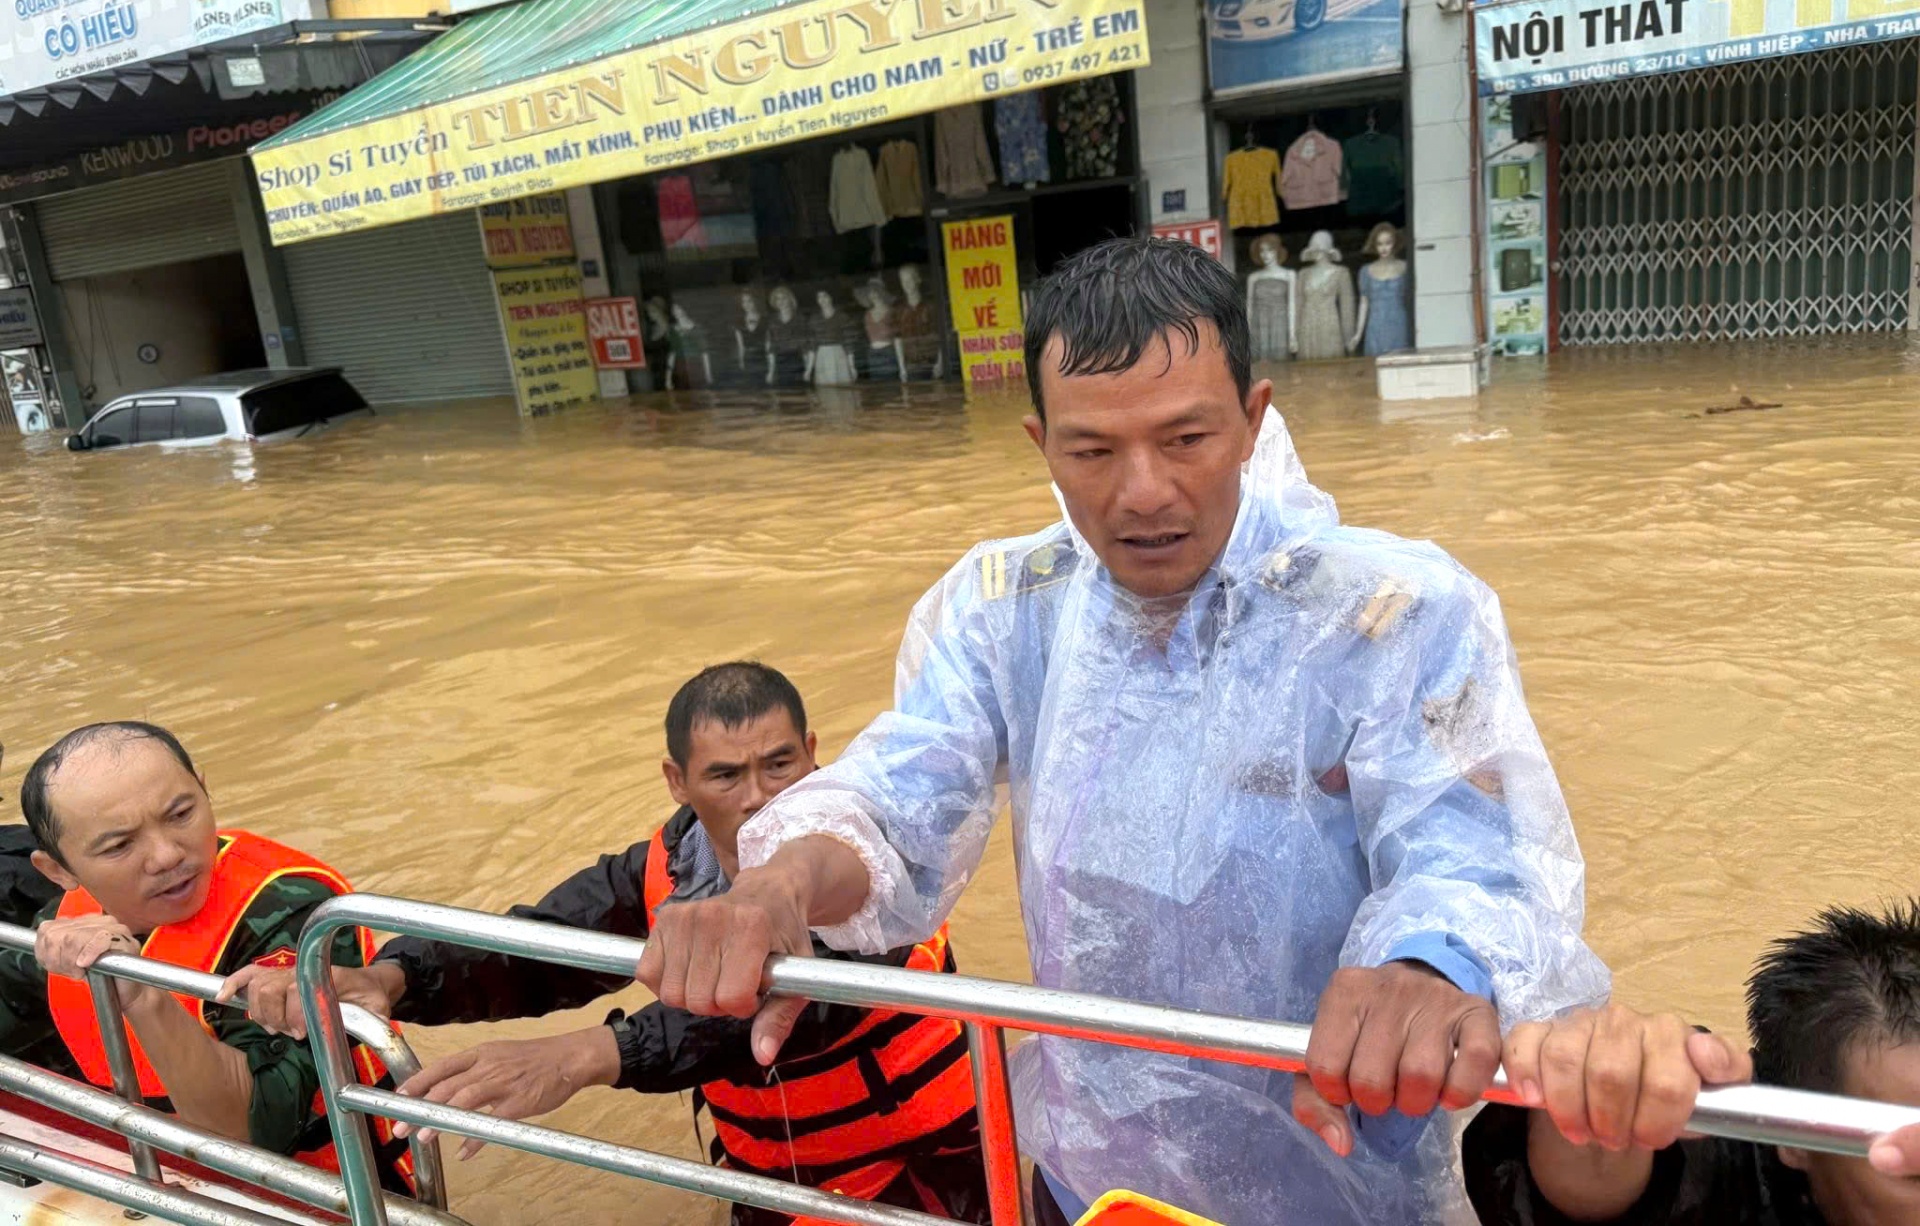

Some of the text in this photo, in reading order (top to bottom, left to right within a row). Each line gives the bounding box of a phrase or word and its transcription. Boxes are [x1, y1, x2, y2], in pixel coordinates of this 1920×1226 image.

[45, 15, 77, 57] CÔ
[1492, 10, 1564, 65] NỘI
[1531, 71, 1563, 87] 390
[1635, 53, 1687, 72] 23/10
[1758, 34, 1804, 55] HIỆP
[1824, 25, 1869, 44] NHA
[1023, 44, 1141, 84] 0937 497 421
[463, 162, 487, 183] TÚI
[644, 119, 681, 143] PHỤ
[830, 72, 877, 100] CHO
[885, 57, 943, 88] NAM
[968, 37, 1008, 69] NỮ
[1033, 16, 1083, 53] TRẺ
[1092, 9, 1139, 40] EM
[260, 163, 320, 192] Shop
[452, 69, 625, 150] TIEN
[800, 117, 827, 134] Tien
[830, 104, 888, 127] Nguyen
[80, 134, 173, 175] KENWOOD
[950, 222, 1006, 250] HÀNG
[963, 260, 1002, 290] MỚI
[588, 303, 639, 338] SALE
